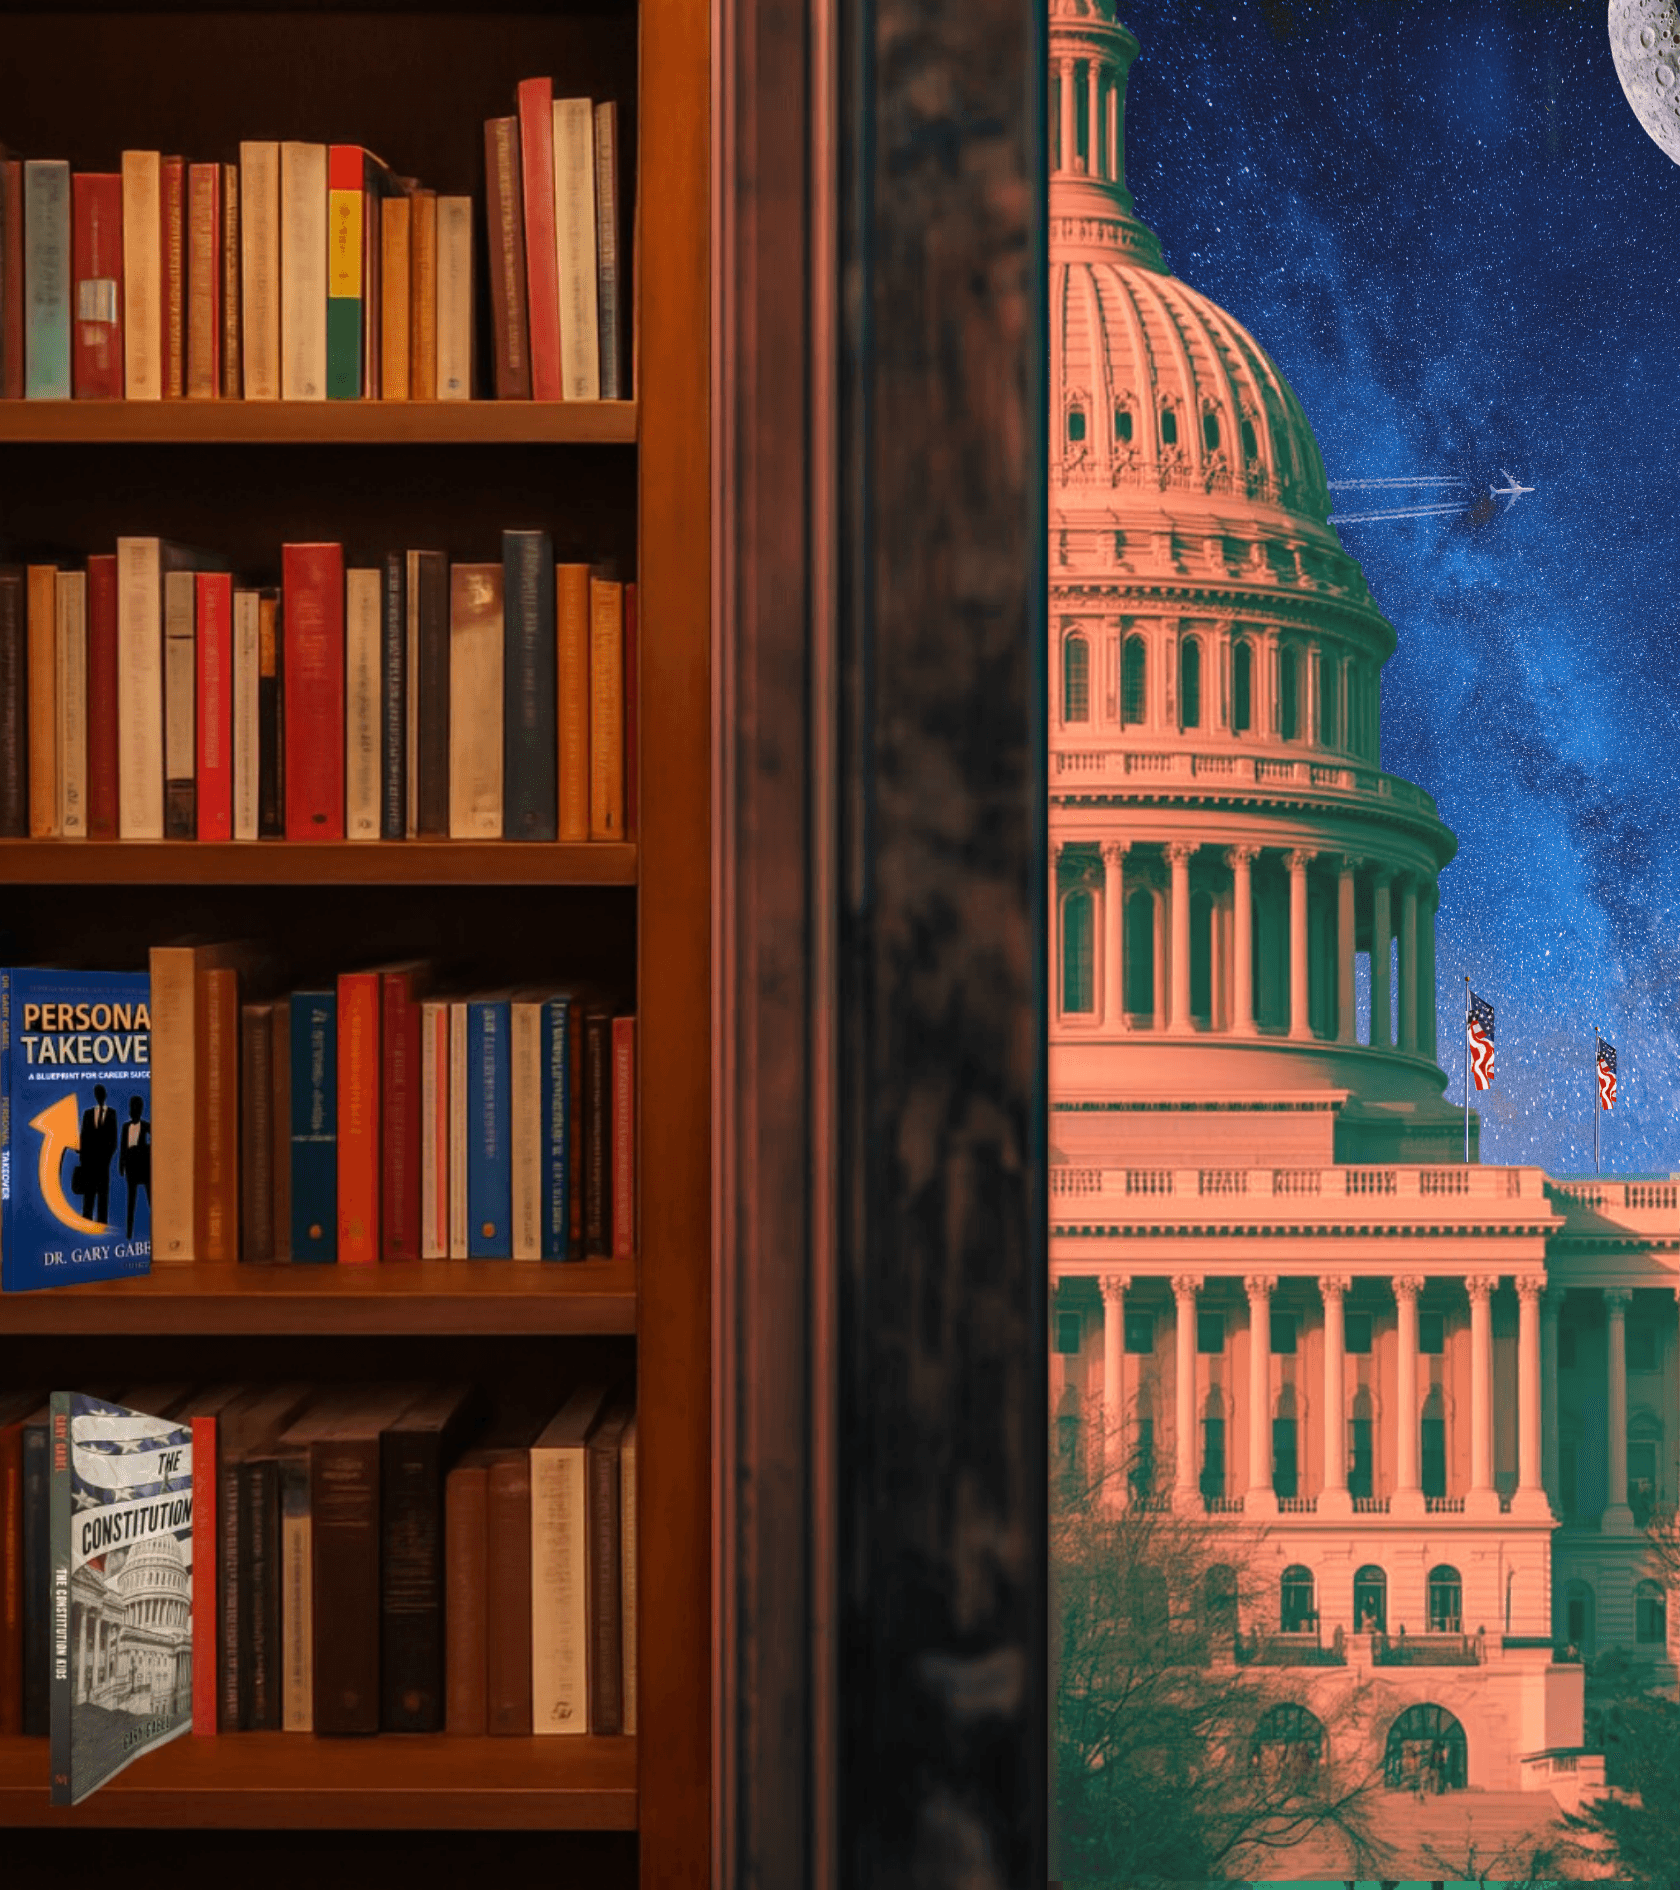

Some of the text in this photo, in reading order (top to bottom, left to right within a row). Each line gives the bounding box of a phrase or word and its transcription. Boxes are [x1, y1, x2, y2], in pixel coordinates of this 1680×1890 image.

[24, 1003, 150, 1031] PERSONA
[20, 1034, 148, 1064] TAKEOVE
[28, 1072, 35, 1080] A
[36, 1070, 79, 1080] BLUEPRINT
[81, 1070, 97, 1079] FOR
[99, 1070, 129, 1079] CAREER
[2, 1150, 10, 1200] TAKEOVER
[44, 1241, 151, 1266] DR. GARY GABE
[55, 1414, 68, 1471] GARY GABEL
[158, 1450, 182, 1476] THE
[82, 1498, 193, 1556] CONSTITUTION
[56, 1569, 67, 1679] THE CONSTITUTION KIDS
